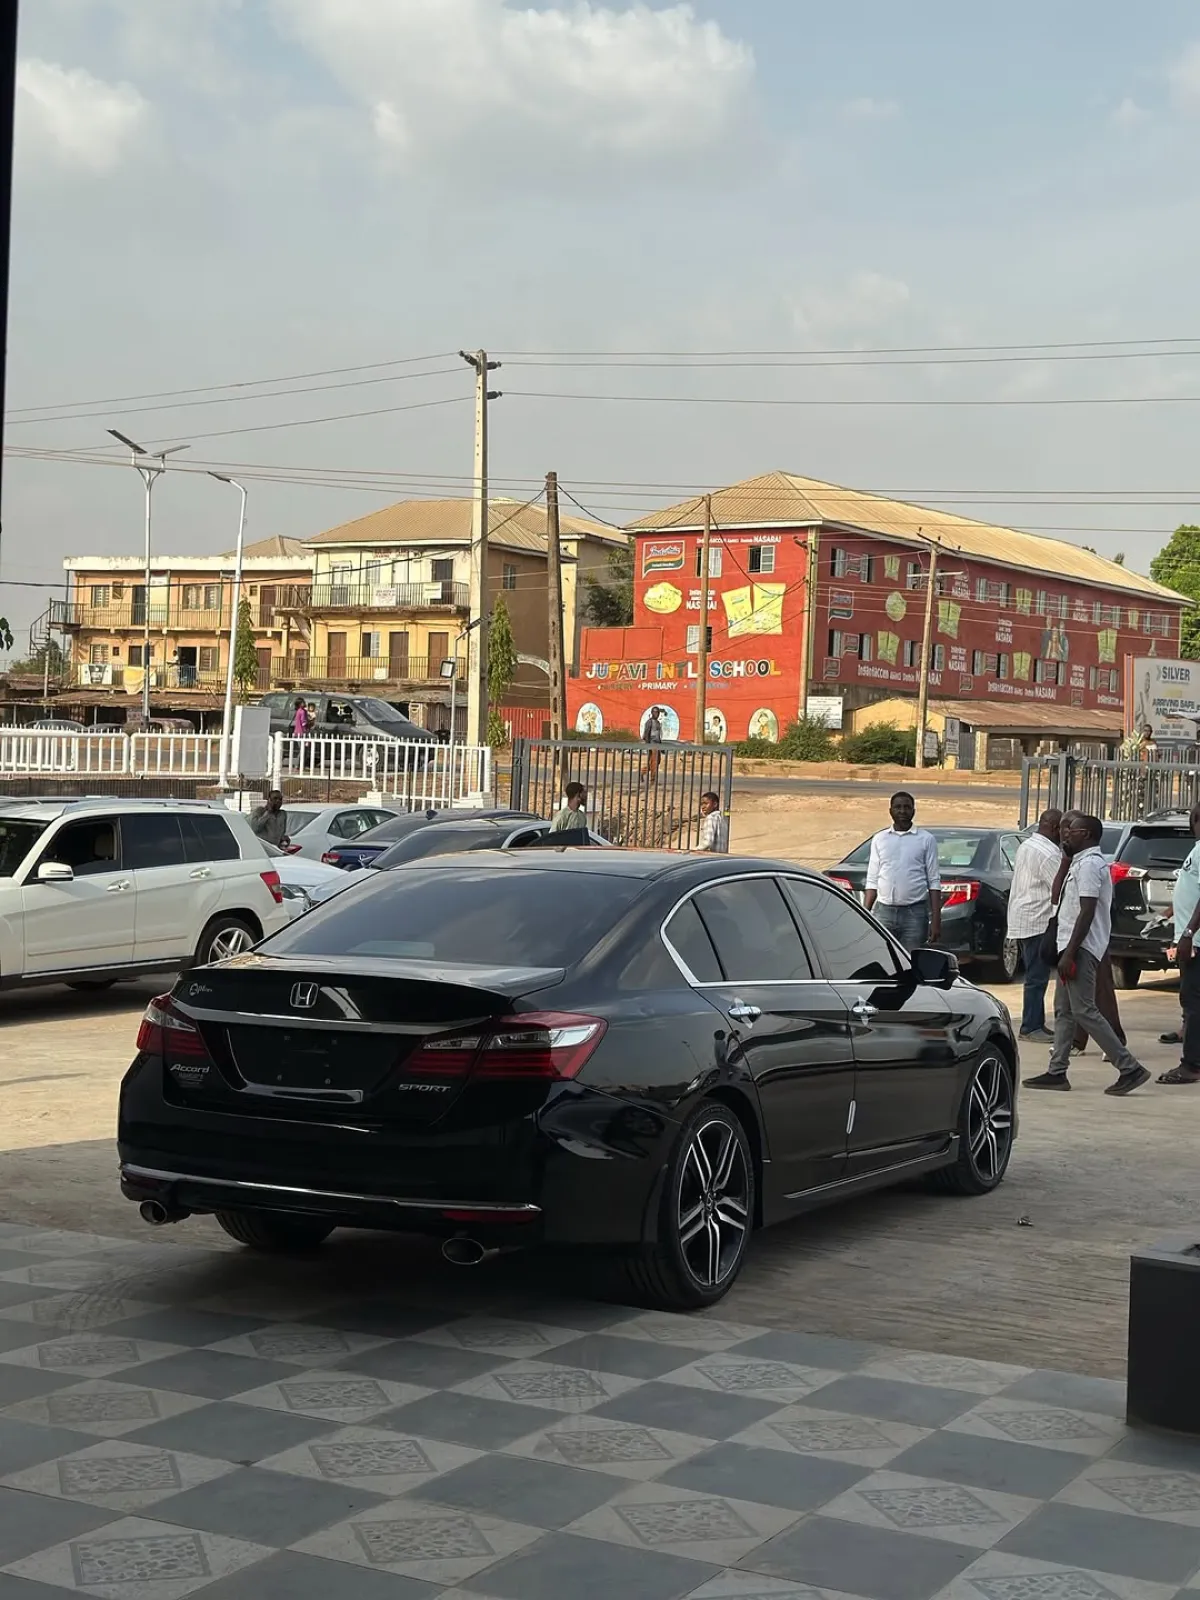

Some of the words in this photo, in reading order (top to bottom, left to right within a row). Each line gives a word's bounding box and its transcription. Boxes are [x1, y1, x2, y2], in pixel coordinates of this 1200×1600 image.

[586, 660, 648, 681] JUPAVI
[709, 658, 782, 679] SCHOOL
[1161, 666, 1191, 681] SILVER
[641, 681, 678, 691] PRIMARY
[170, 1063, 210, 1073] Accord
[399, 1083, 452, 1093] SPORT
